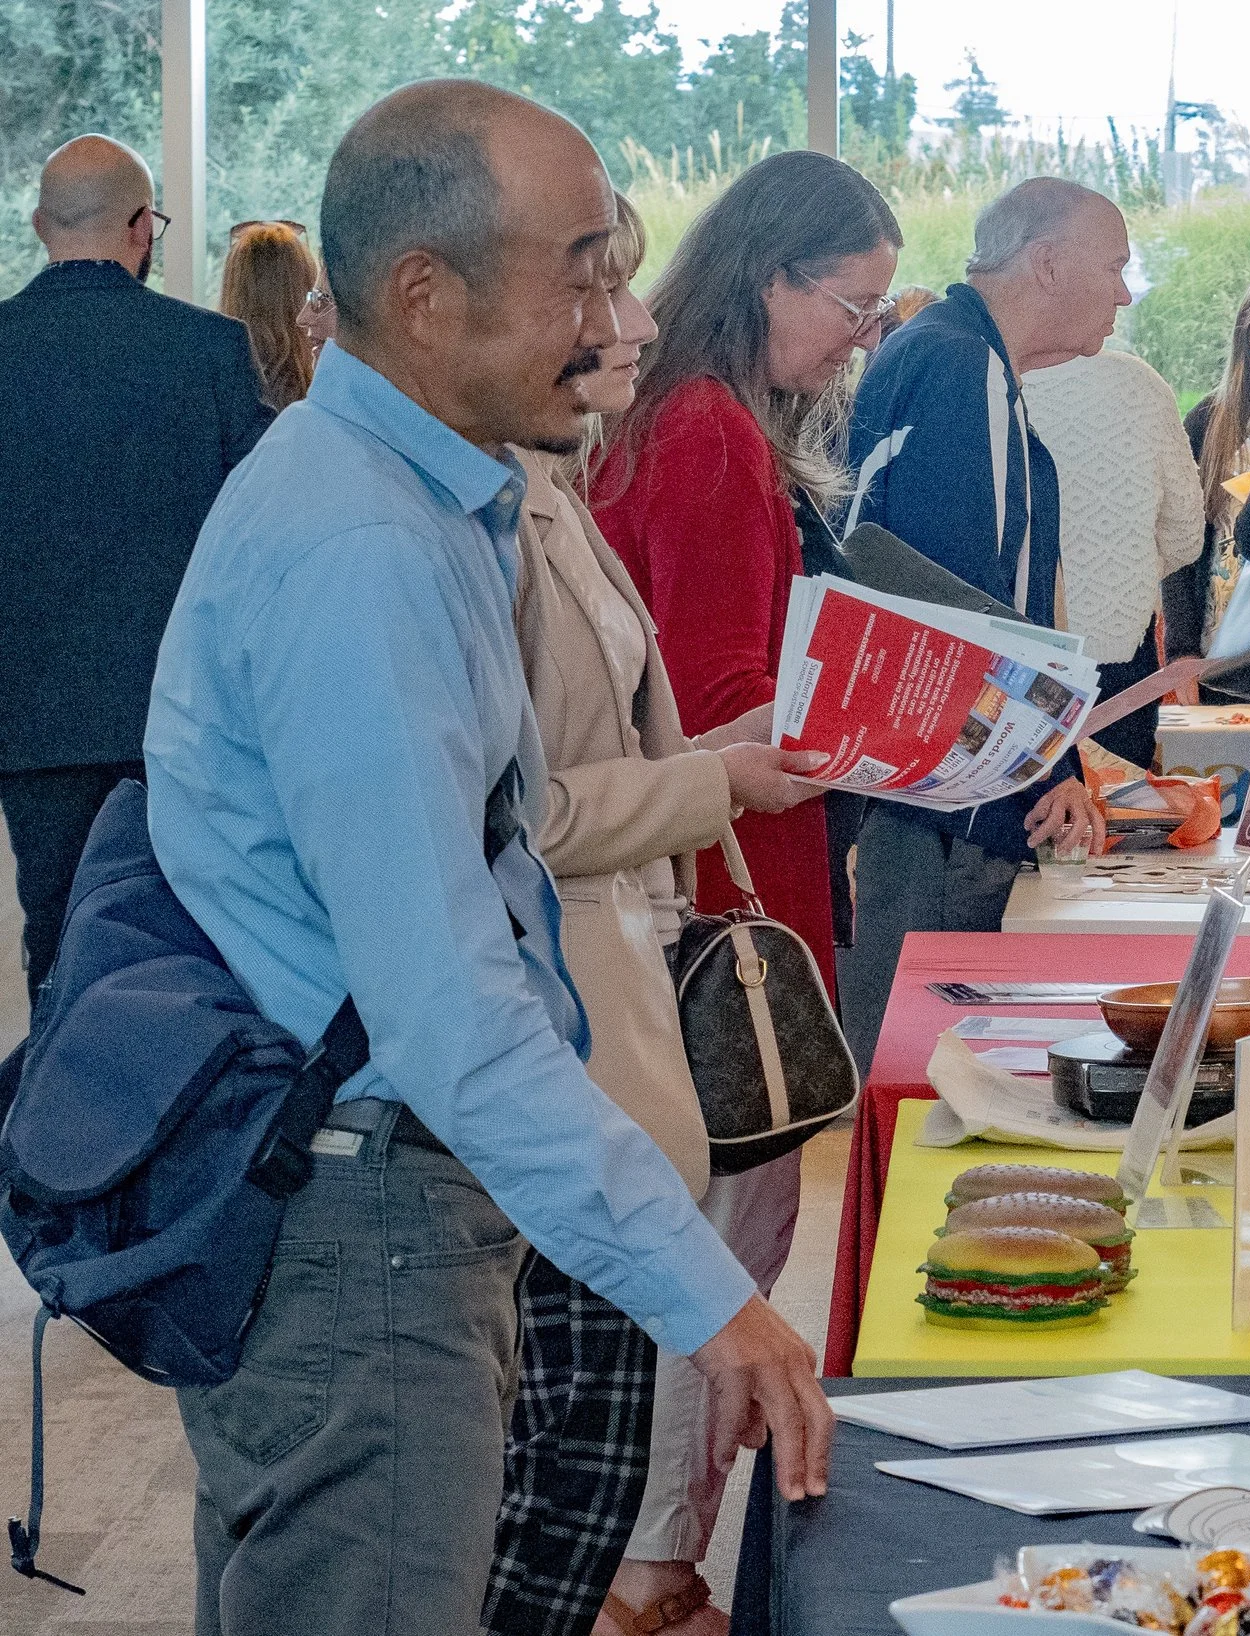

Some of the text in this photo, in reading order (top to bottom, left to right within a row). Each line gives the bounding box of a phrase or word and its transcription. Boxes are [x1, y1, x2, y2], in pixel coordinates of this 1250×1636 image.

[911, 631, 919, 642] be
[954, 641, 965, 658] Join
[797, 660, 808, 681] SCHOOL
[898, 642, 915, 680] streamed
[931, 657, 939, 668] on
[906, 649, 933, 715] environment and
[943, 658, 960, 692] Stanford
[793, 662, 818, 723] Stanford DOERR
[894, 680, 903, 693] via
[916, 641, 955, 737] virtual book talks focused
[897, 681, 913, 715] Sessions
[916, 700, 926, 714] the
[939, 692, 948, 704] for
[783, 690, 798, 730] SUSTAINABILITY
[892, 715, 901, 728] will
[926, 711, 940, 734] series
[855, 725, 867, 743] Find
[922, 734, 930, 743] of
[988, 721, 1015, 758] Woods
[966, 758, 991, 780] Book
